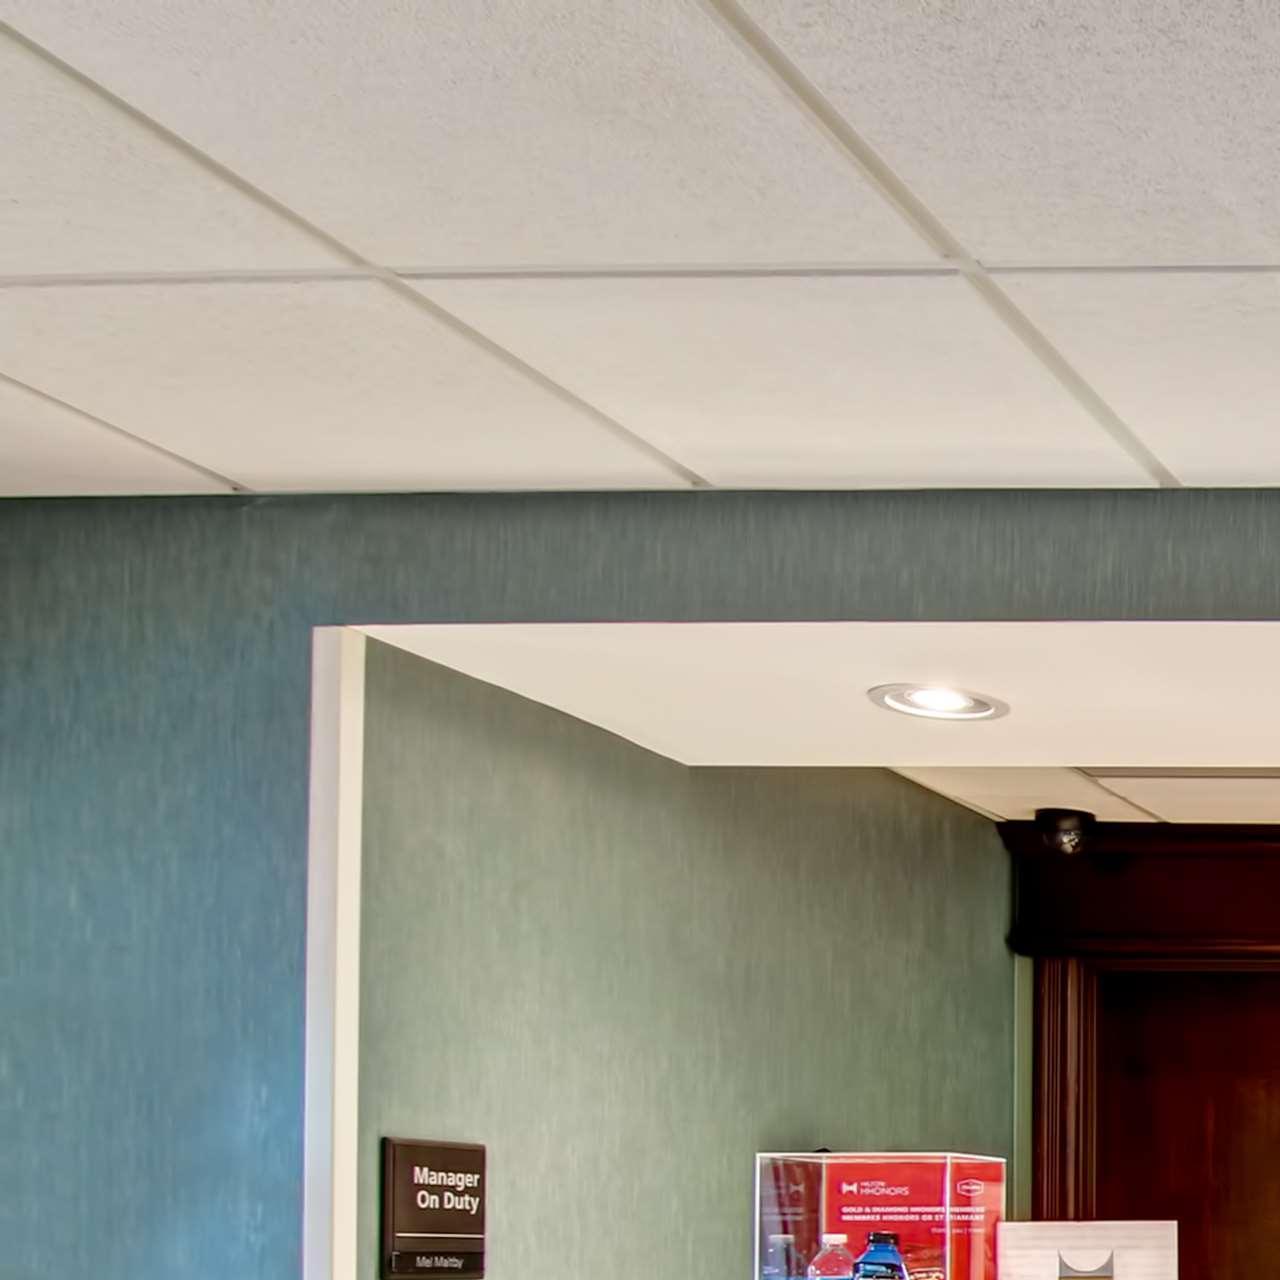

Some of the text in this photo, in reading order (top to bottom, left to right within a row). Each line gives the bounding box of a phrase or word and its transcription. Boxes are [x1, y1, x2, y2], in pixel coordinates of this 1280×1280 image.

[413, 1166, 480, 1191] Manager
[416, 1190, 480, 1215] On Duty
